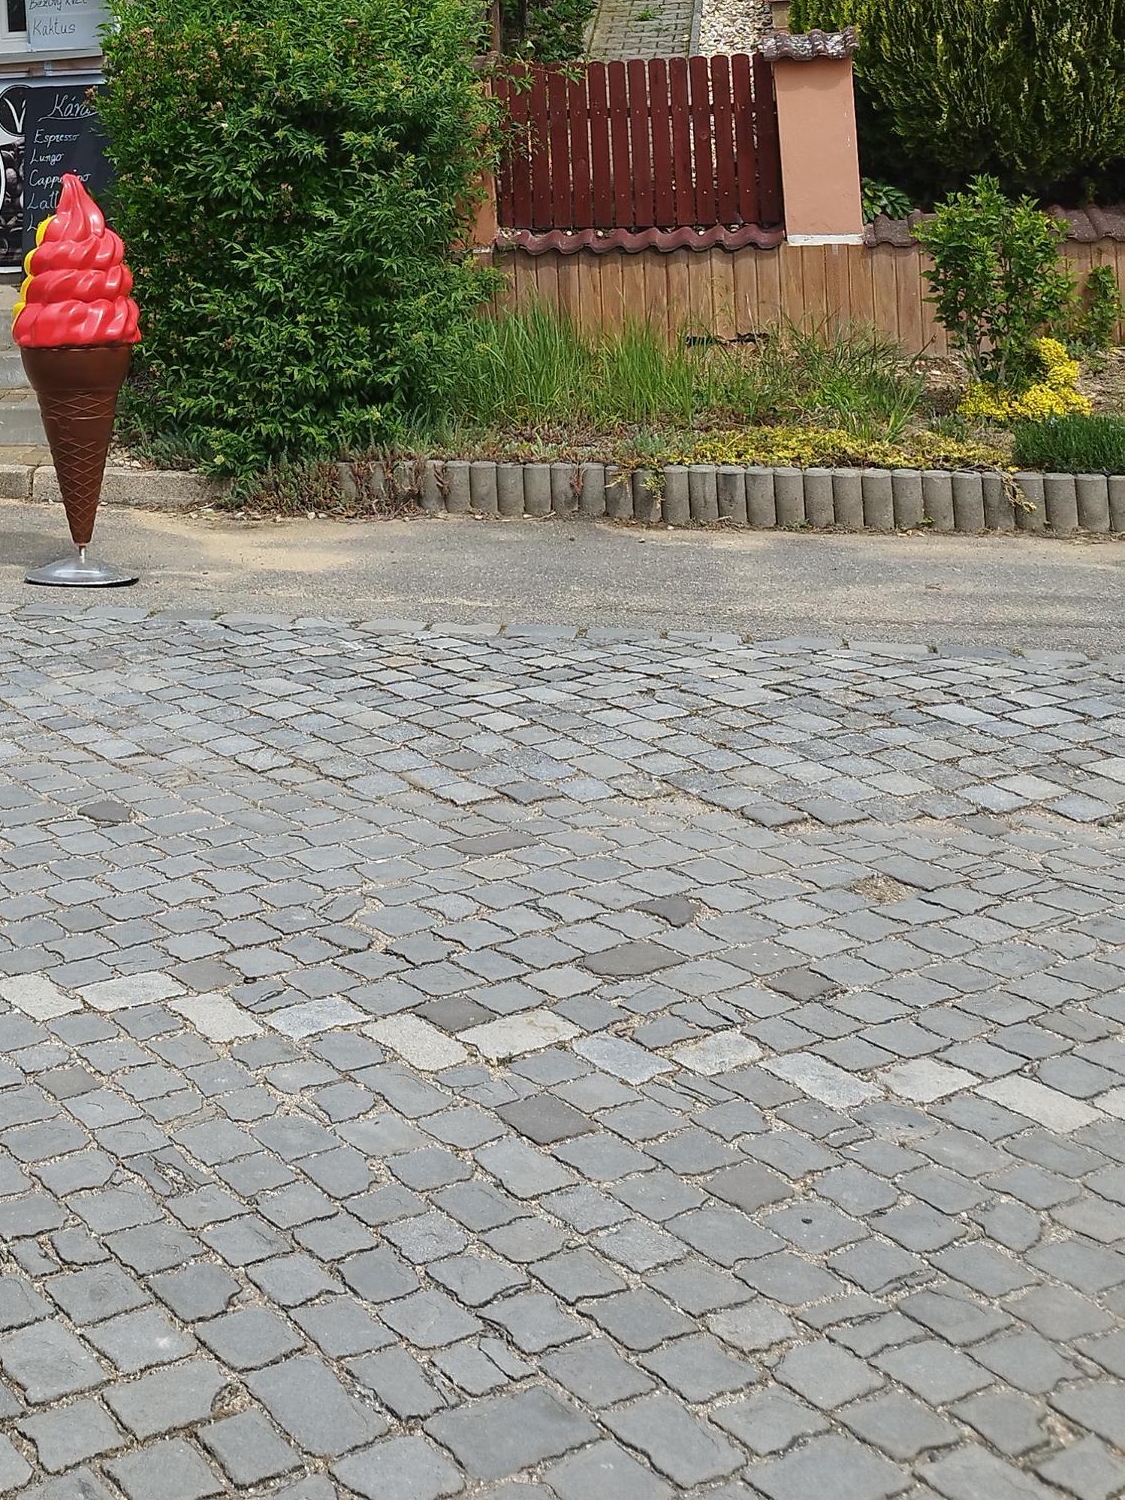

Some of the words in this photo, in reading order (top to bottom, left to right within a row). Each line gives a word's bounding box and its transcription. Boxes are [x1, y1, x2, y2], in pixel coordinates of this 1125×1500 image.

[33, 128, 80, 148] Espresso
[29, 148, 65, 166] Lungo
[26, 190, 60, 210] Latt
